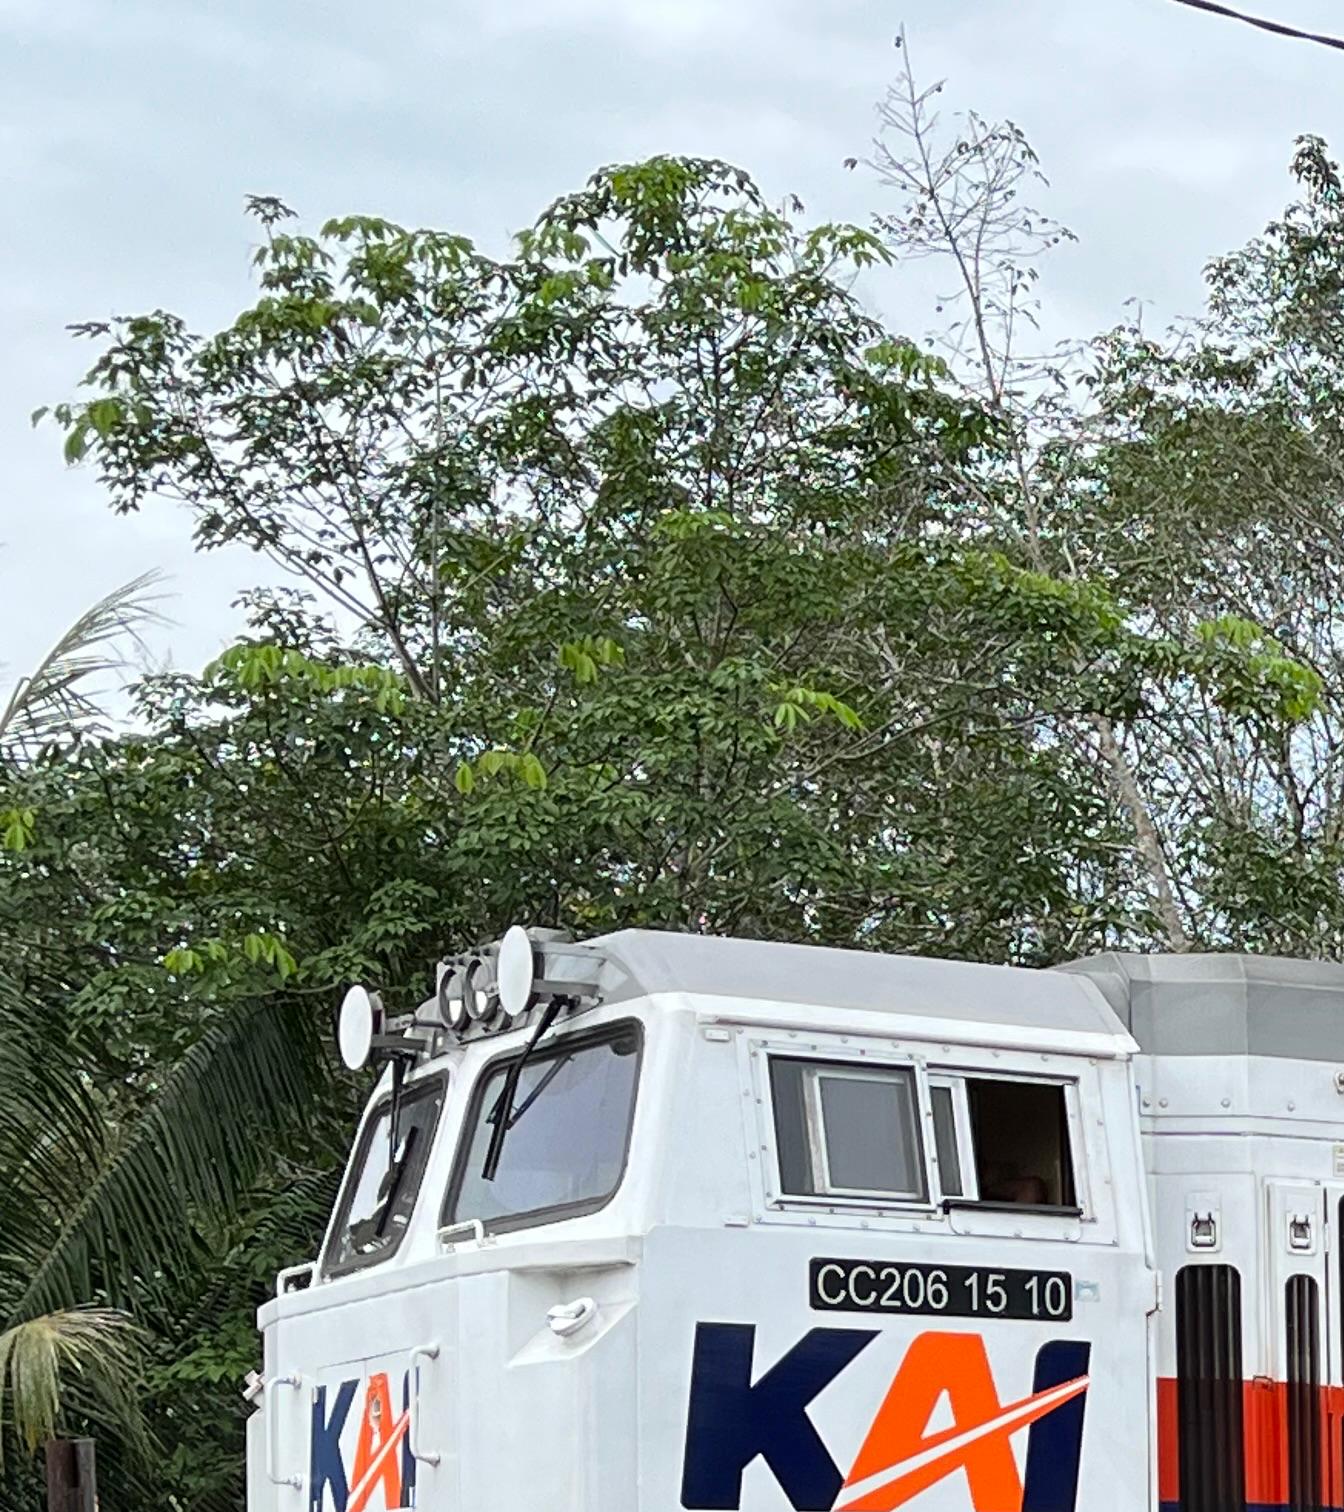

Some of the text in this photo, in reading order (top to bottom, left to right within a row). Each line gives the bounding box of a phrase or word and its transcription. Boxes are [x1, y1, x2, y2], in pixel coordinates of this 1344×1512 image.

[816, 1263, 1067, 1316] CC206 15 10
